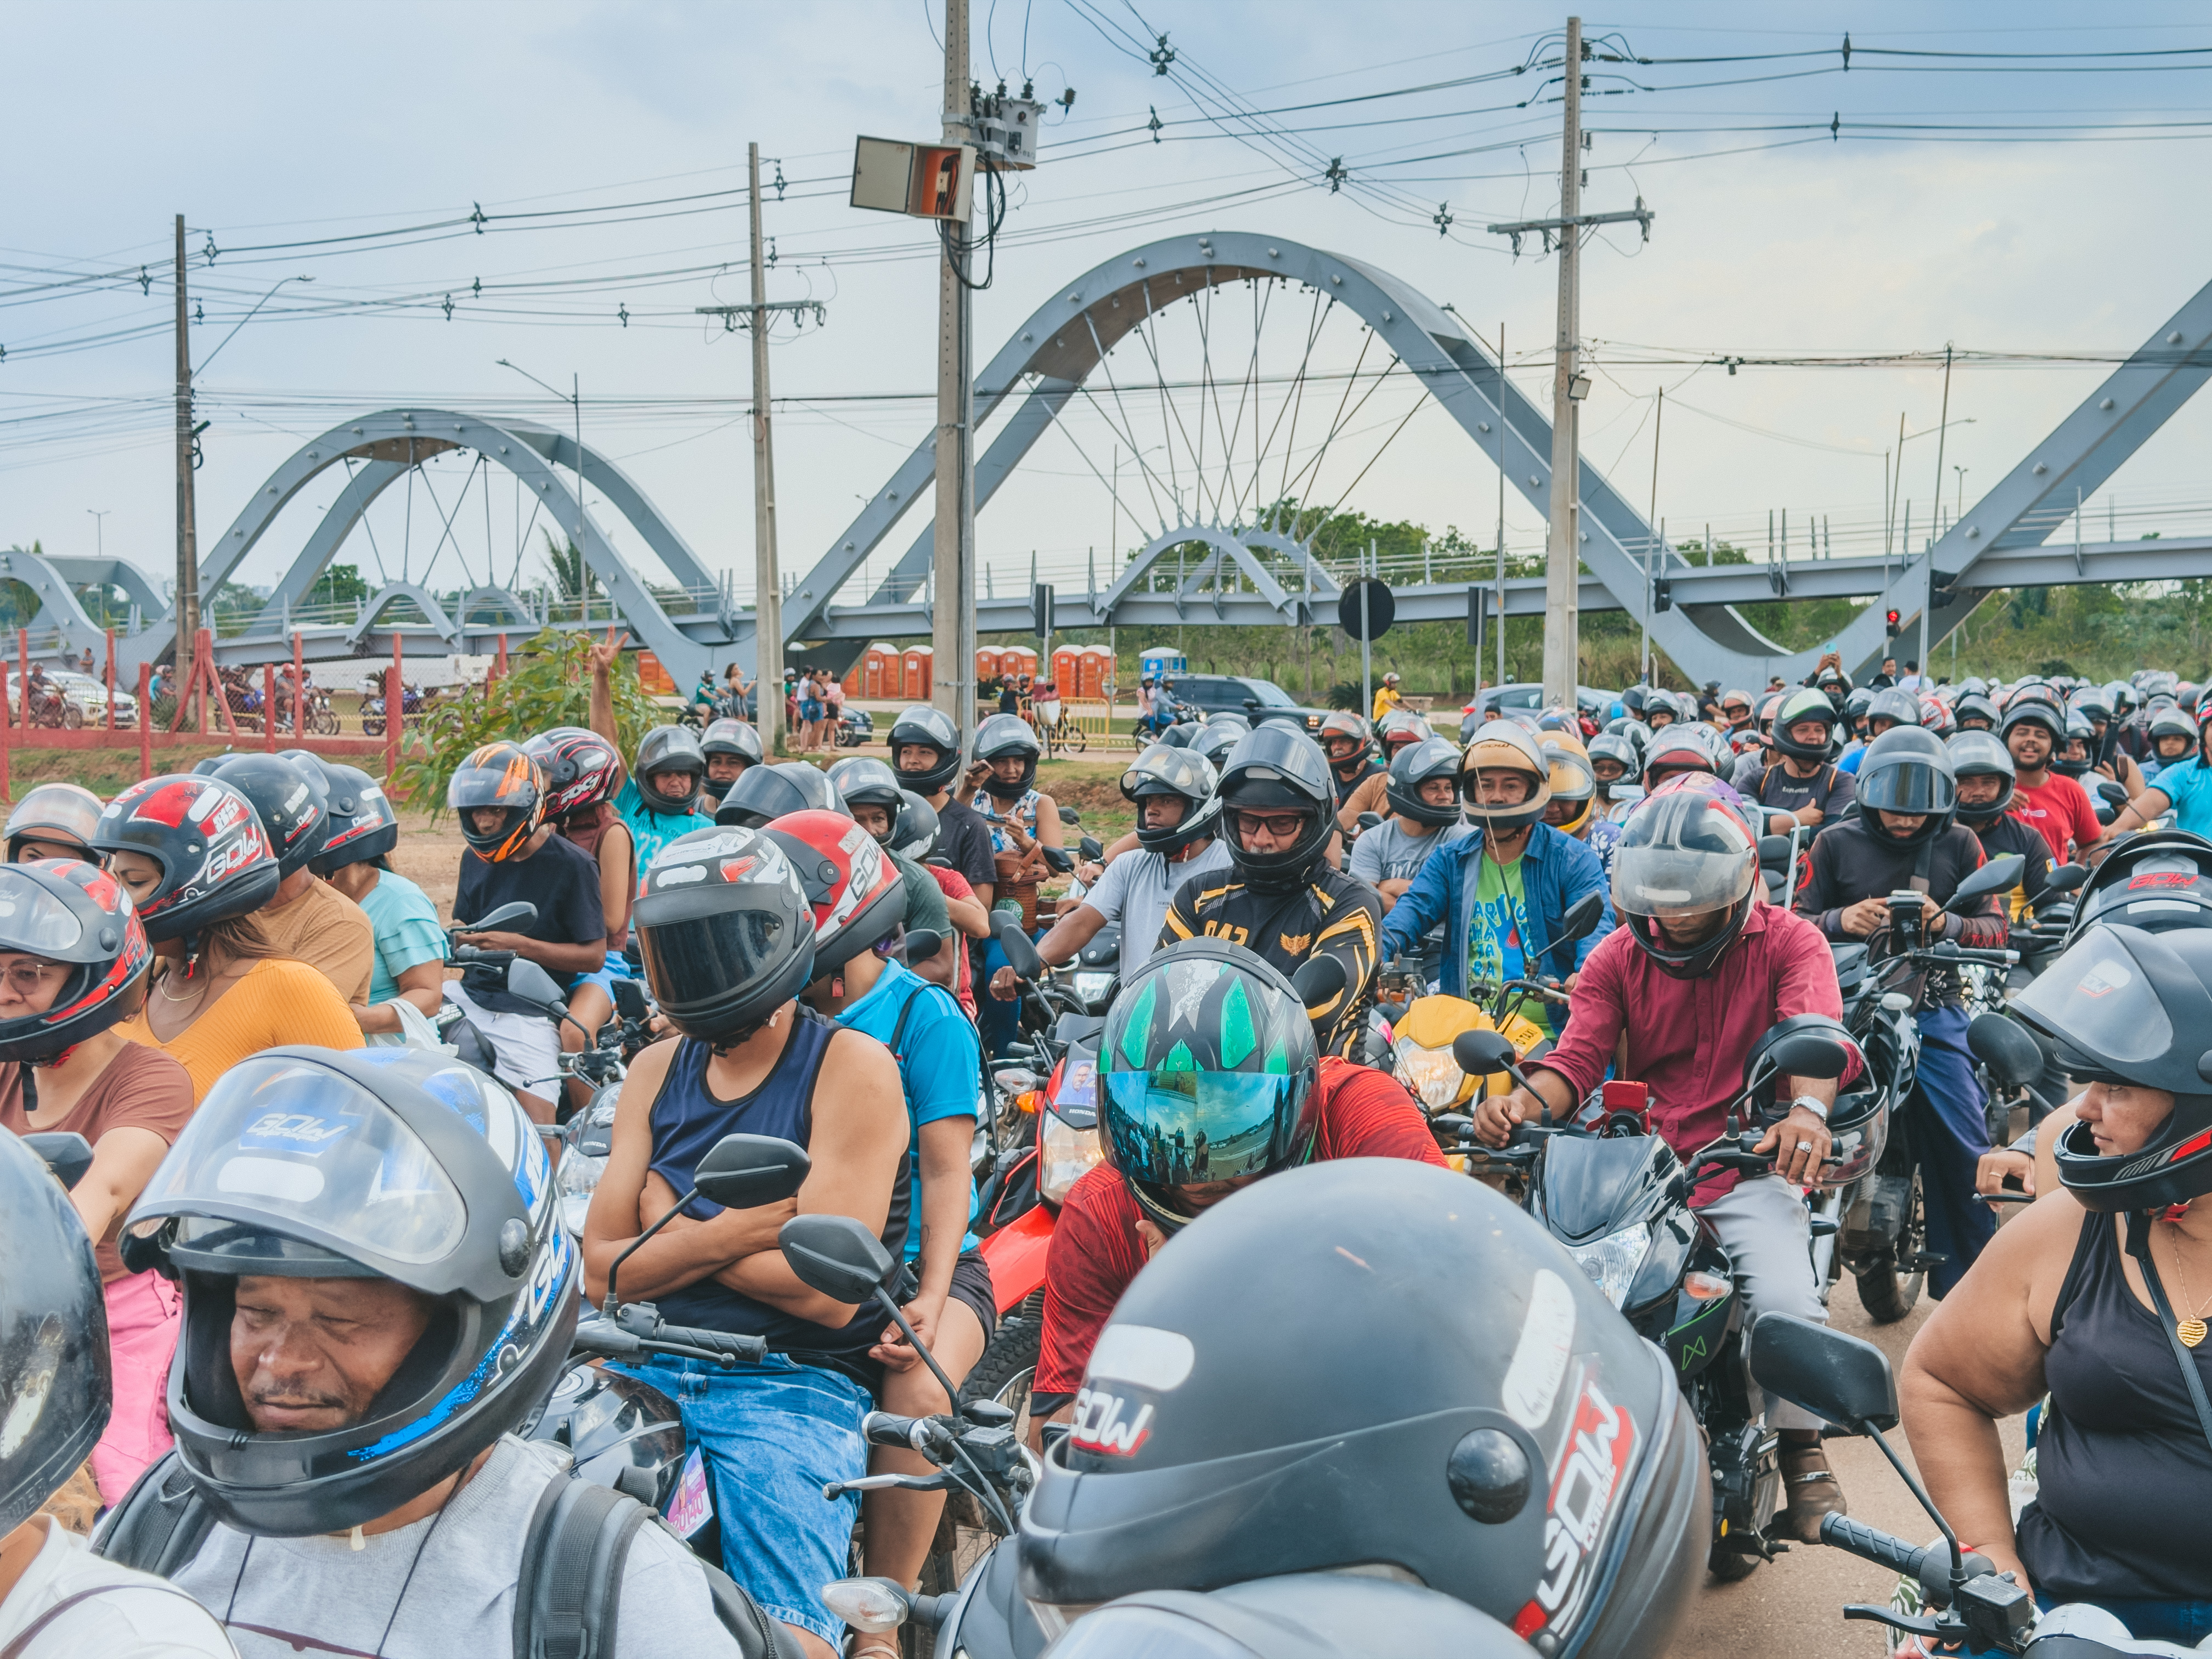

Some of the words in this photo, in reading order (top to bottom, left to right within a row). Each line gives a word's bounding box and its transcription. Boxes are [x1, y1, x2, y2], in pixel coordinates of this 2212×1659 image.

[213, 796, 240, 834] 85
[206, 823, 261, 884] GOW
[2128, 872, 2199, 890] GOW
[246, 1113, 347, 1141] GOW
[1069, 1109, 1096, 1117] HONDA
[582, 1141, 607, 1149] HONDA
[1536, 1379, 1620, 1612] GOW
